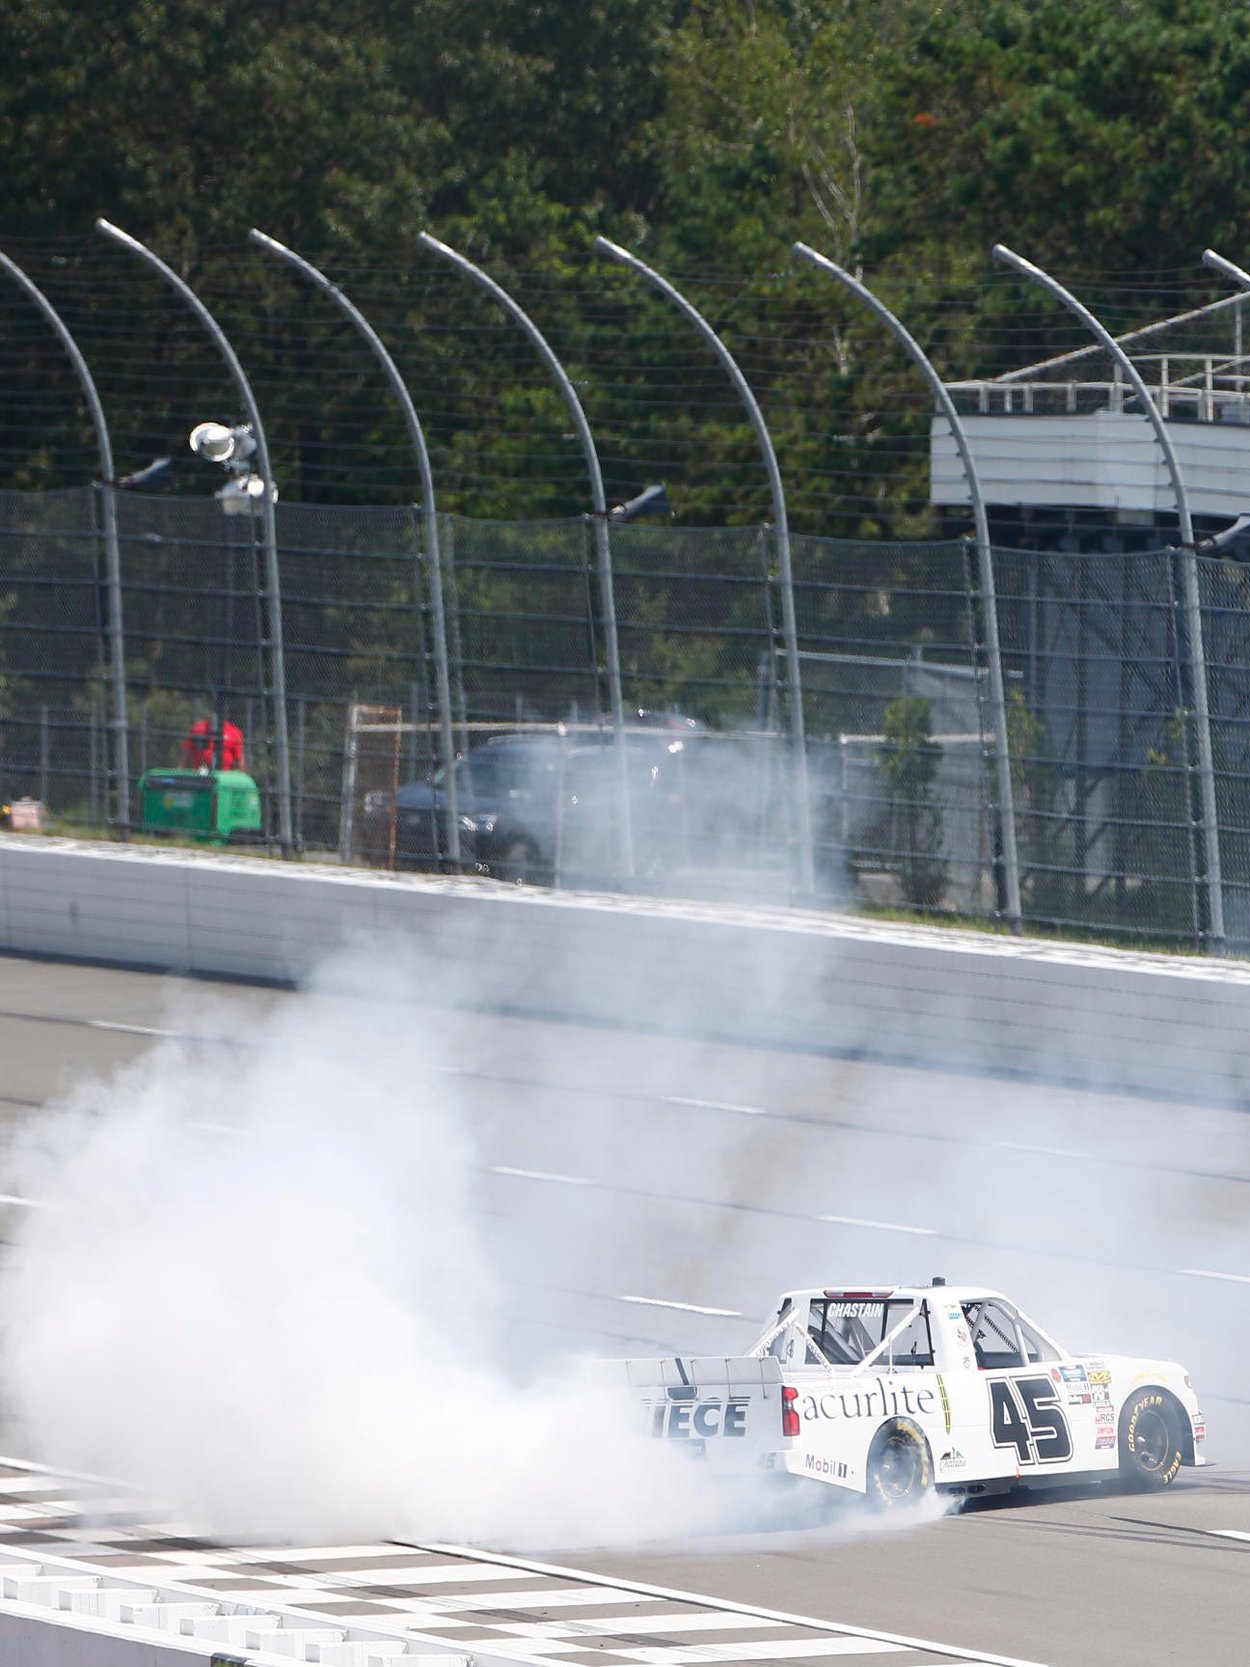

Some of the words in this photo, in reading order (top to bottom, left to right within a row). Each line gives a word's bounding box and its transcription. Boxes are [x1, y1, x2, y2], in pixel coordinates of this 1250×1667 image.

[828, 1303, 885, 1318] CHASTAIN
[802, 1377, 936, 1420] acurlite
[988, 1374, 1073, 1466] 45
[1127, 1395, 1163, 1452] GOODYEAR
[805, 1453, 836, 1476] Mobil
[838, 1462, 848, 1478] 1
[1162, 1450, 1182, 1484] EAGLE
